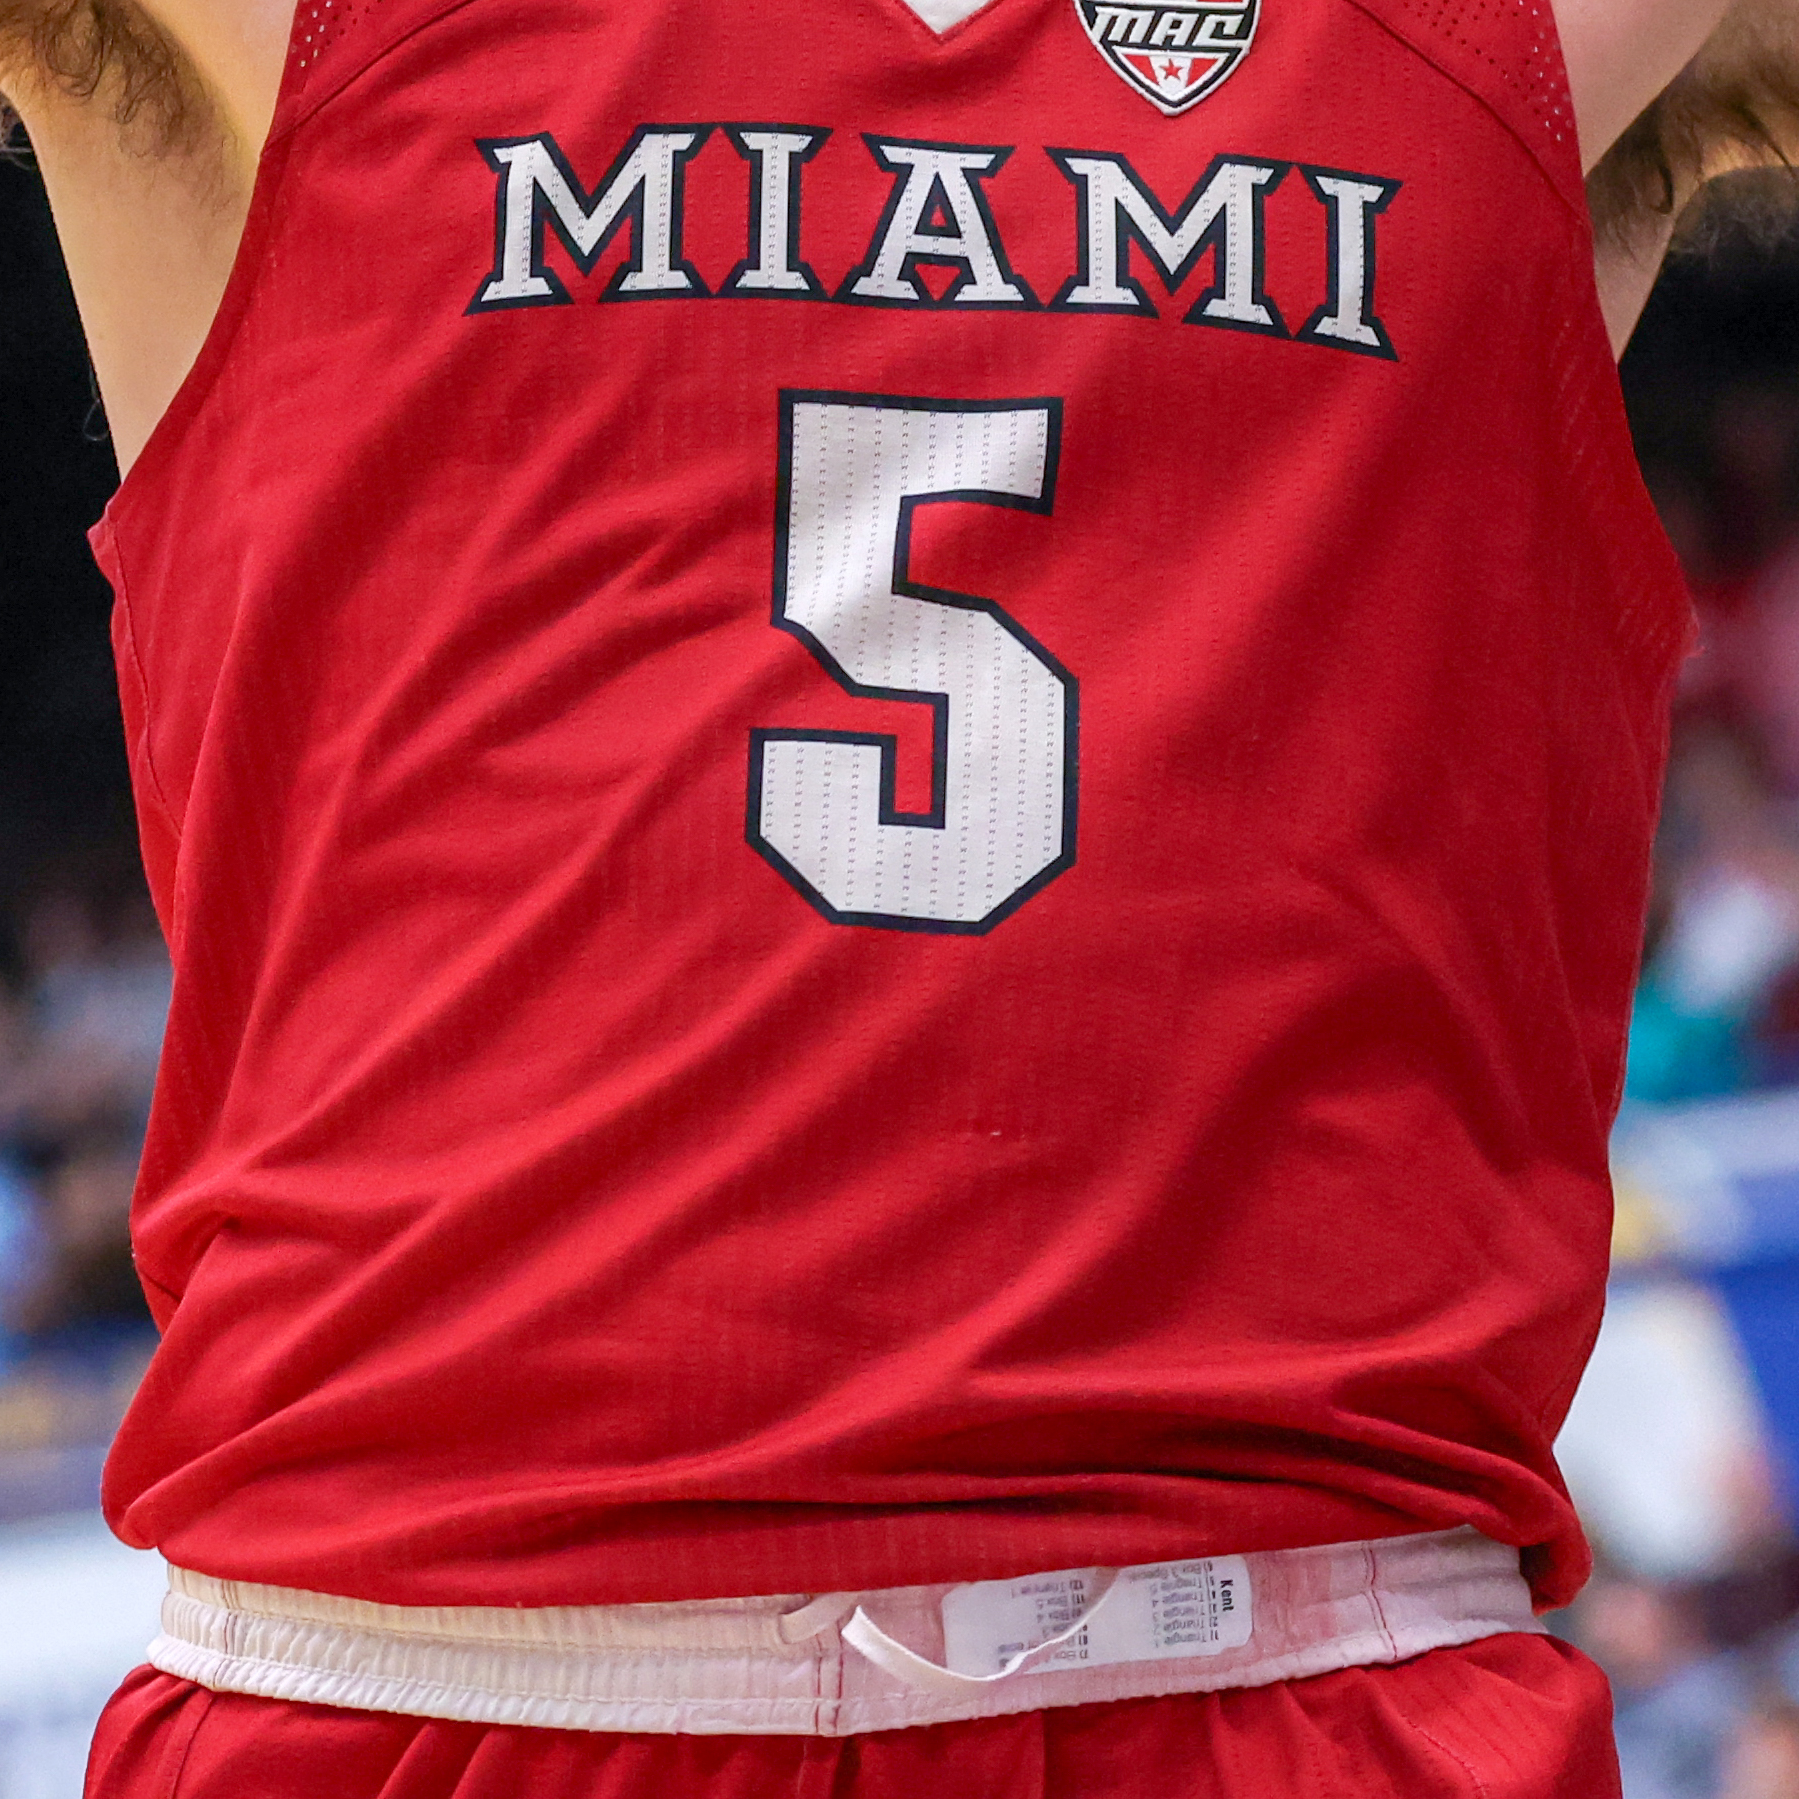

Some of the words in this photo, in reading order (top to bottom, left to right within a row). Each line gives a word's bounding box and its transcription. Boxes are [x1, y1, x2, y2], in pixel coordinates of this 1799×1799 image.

[1092, 5, 1250, 48] MAC
[464, 122, 1402, 362] MIAMI
[744, 388, 1079, 936] 5
[1220, 1579, 1234, 1612] Kent
[1163, 1619, 1205, 1632] Triangle
